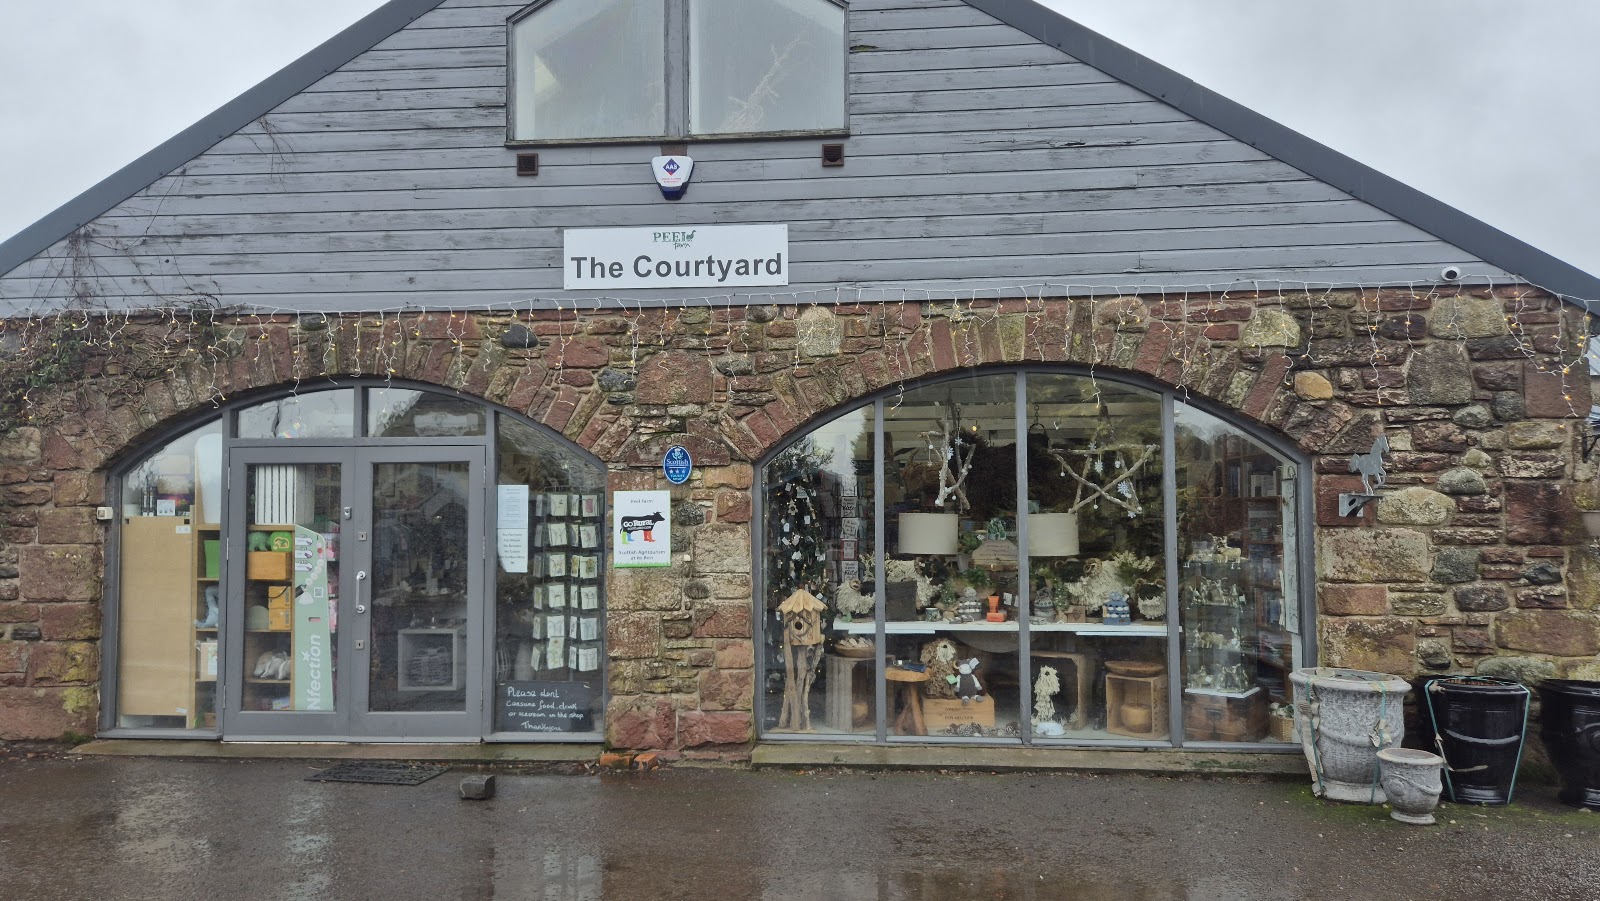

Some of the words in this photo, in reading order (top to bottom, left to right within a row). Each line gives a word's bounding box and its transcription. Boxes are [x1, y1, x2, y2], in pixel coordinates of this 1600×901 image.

[570, 256, 624, 279] The
[633, 253, 782, 282] Courtyard
[507, 686, 537, 697] Please
[568, 712, 584, 720] shop
